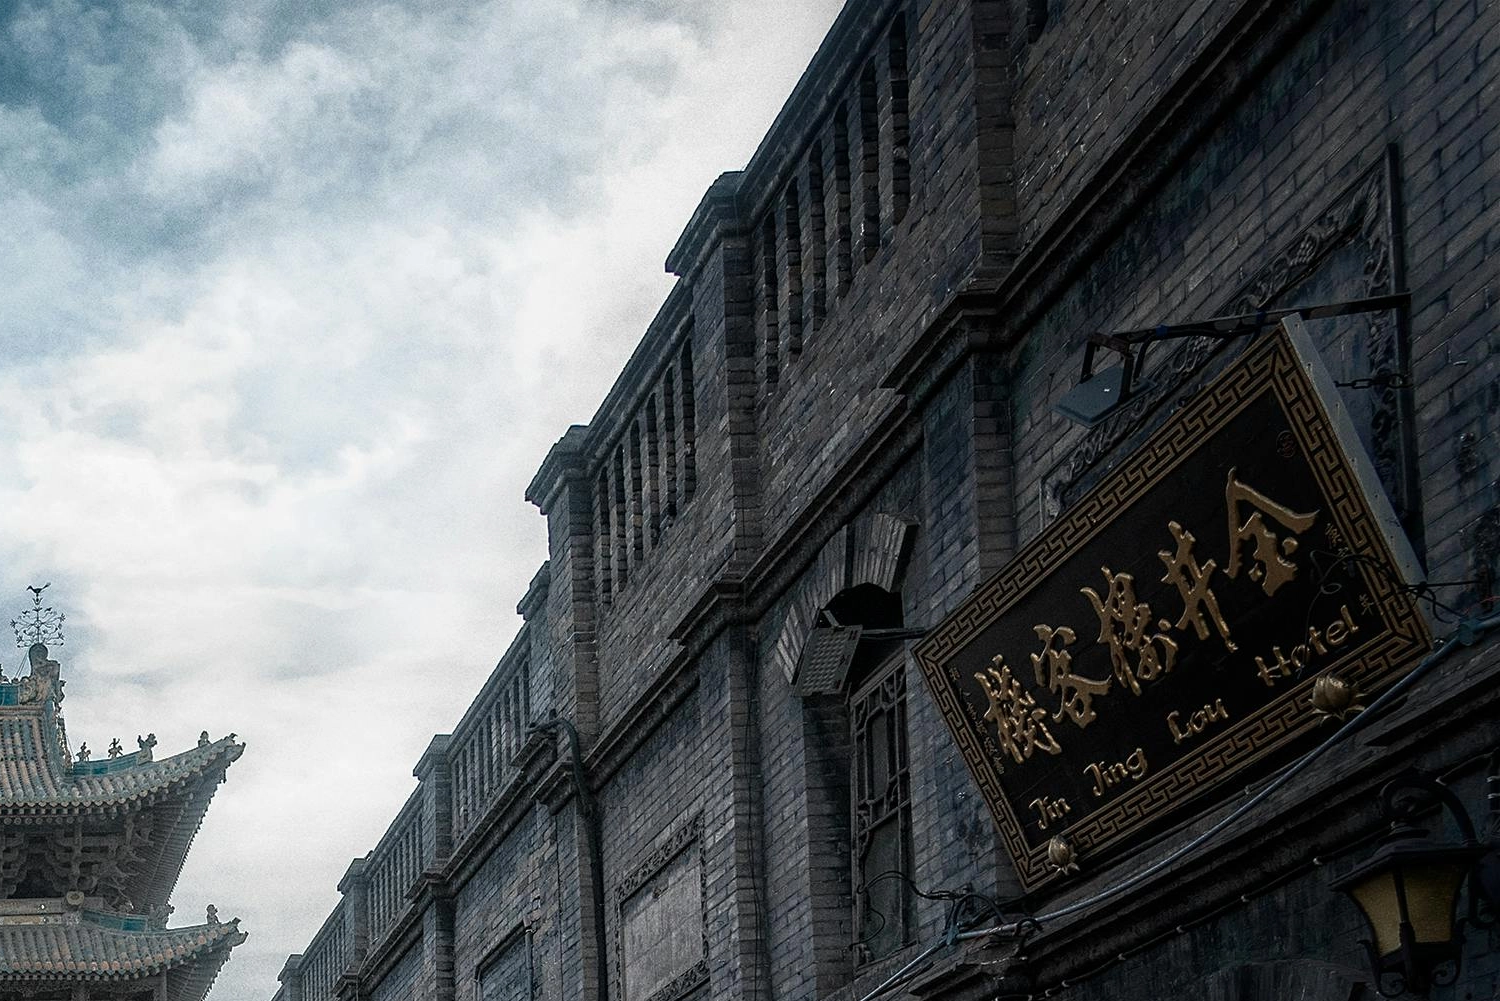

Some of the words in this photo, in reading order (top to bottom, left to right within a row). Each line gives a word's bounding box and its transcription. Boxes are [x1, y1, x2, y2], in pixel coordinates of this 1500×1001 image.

[1029, 795, 1073, 831] Jin
[1083, 747, 1149, 798] Jing
[1165, 697, 1231, 746] Lou
[1254, 604, 1361, 688] Hotel
